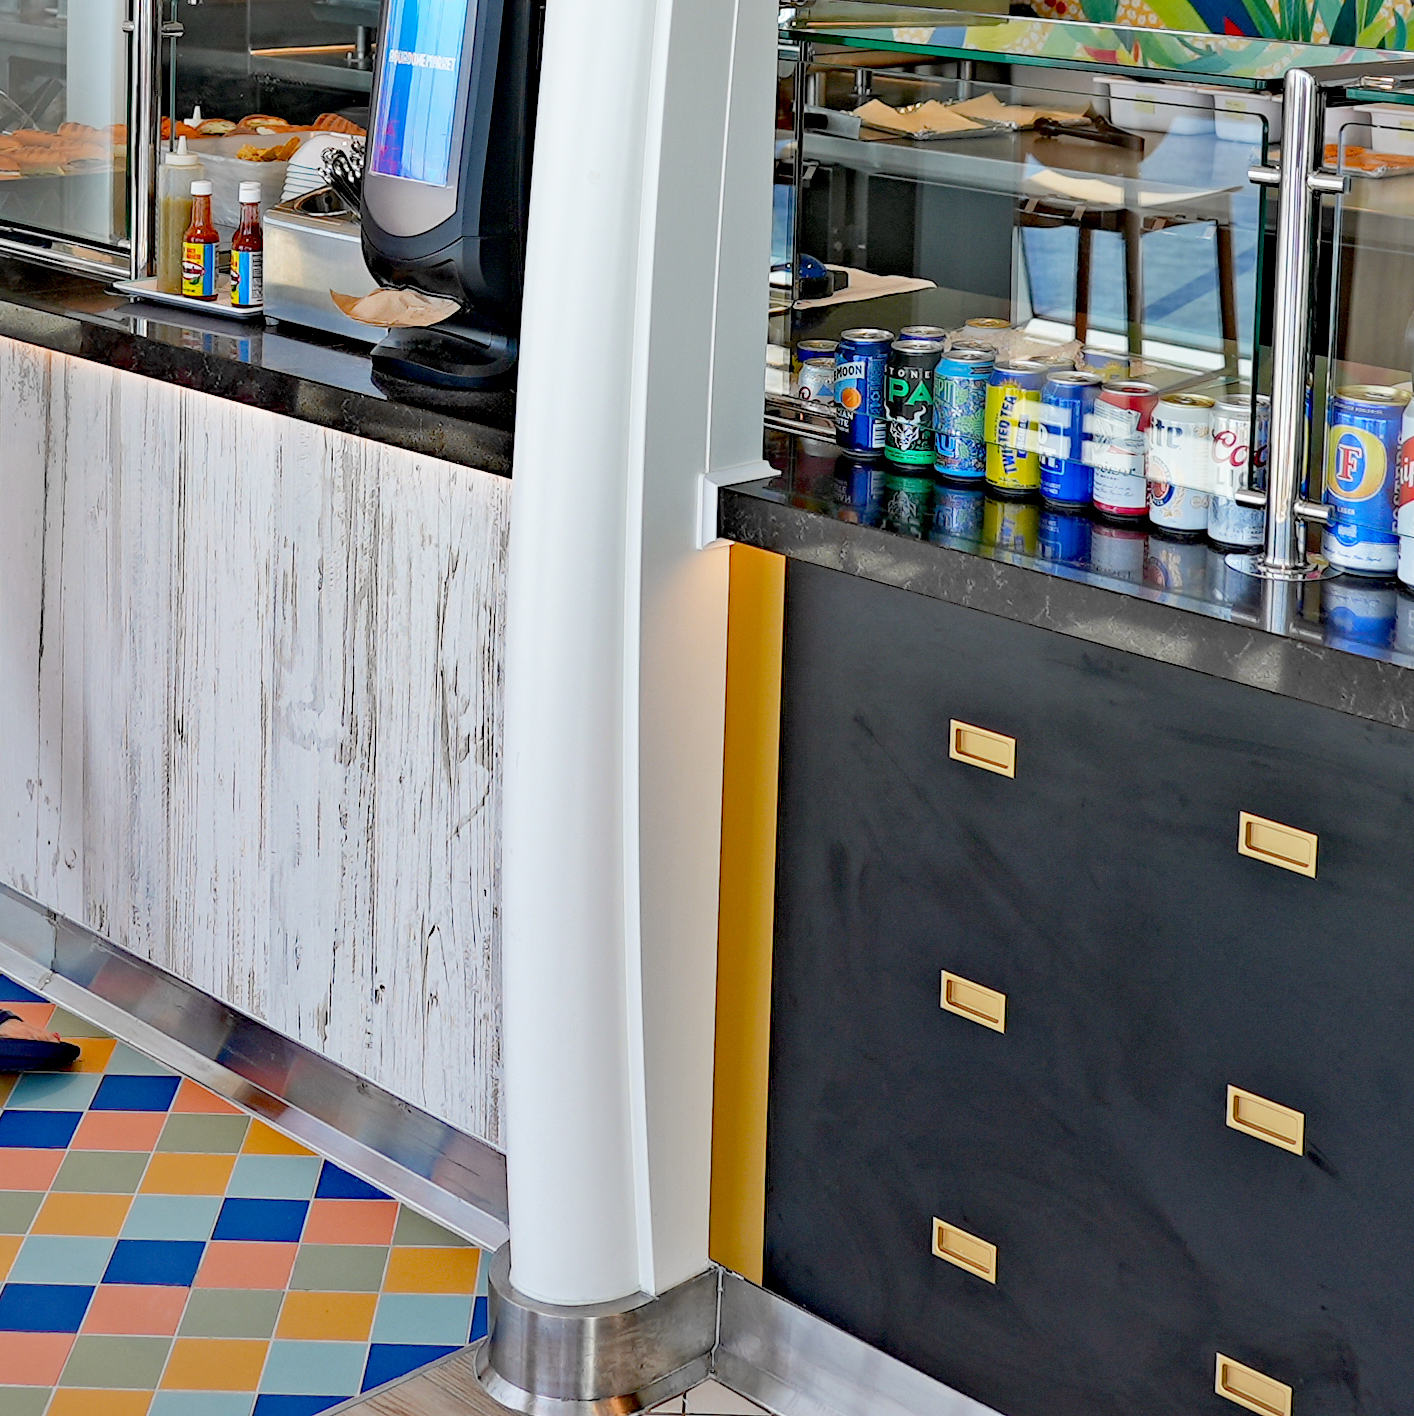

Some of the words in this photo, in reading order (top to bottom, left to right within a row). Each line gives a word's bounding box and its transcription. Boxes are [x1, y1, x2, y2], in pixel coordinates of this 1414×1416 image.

[888, 367, 932, 379] TONE
[888, 377, 934, 405] PA
[1000, 395, 1017, 418] TEA
[1151, 416, 1183, 449] ite
[1337, 444, 1363, 482] F
